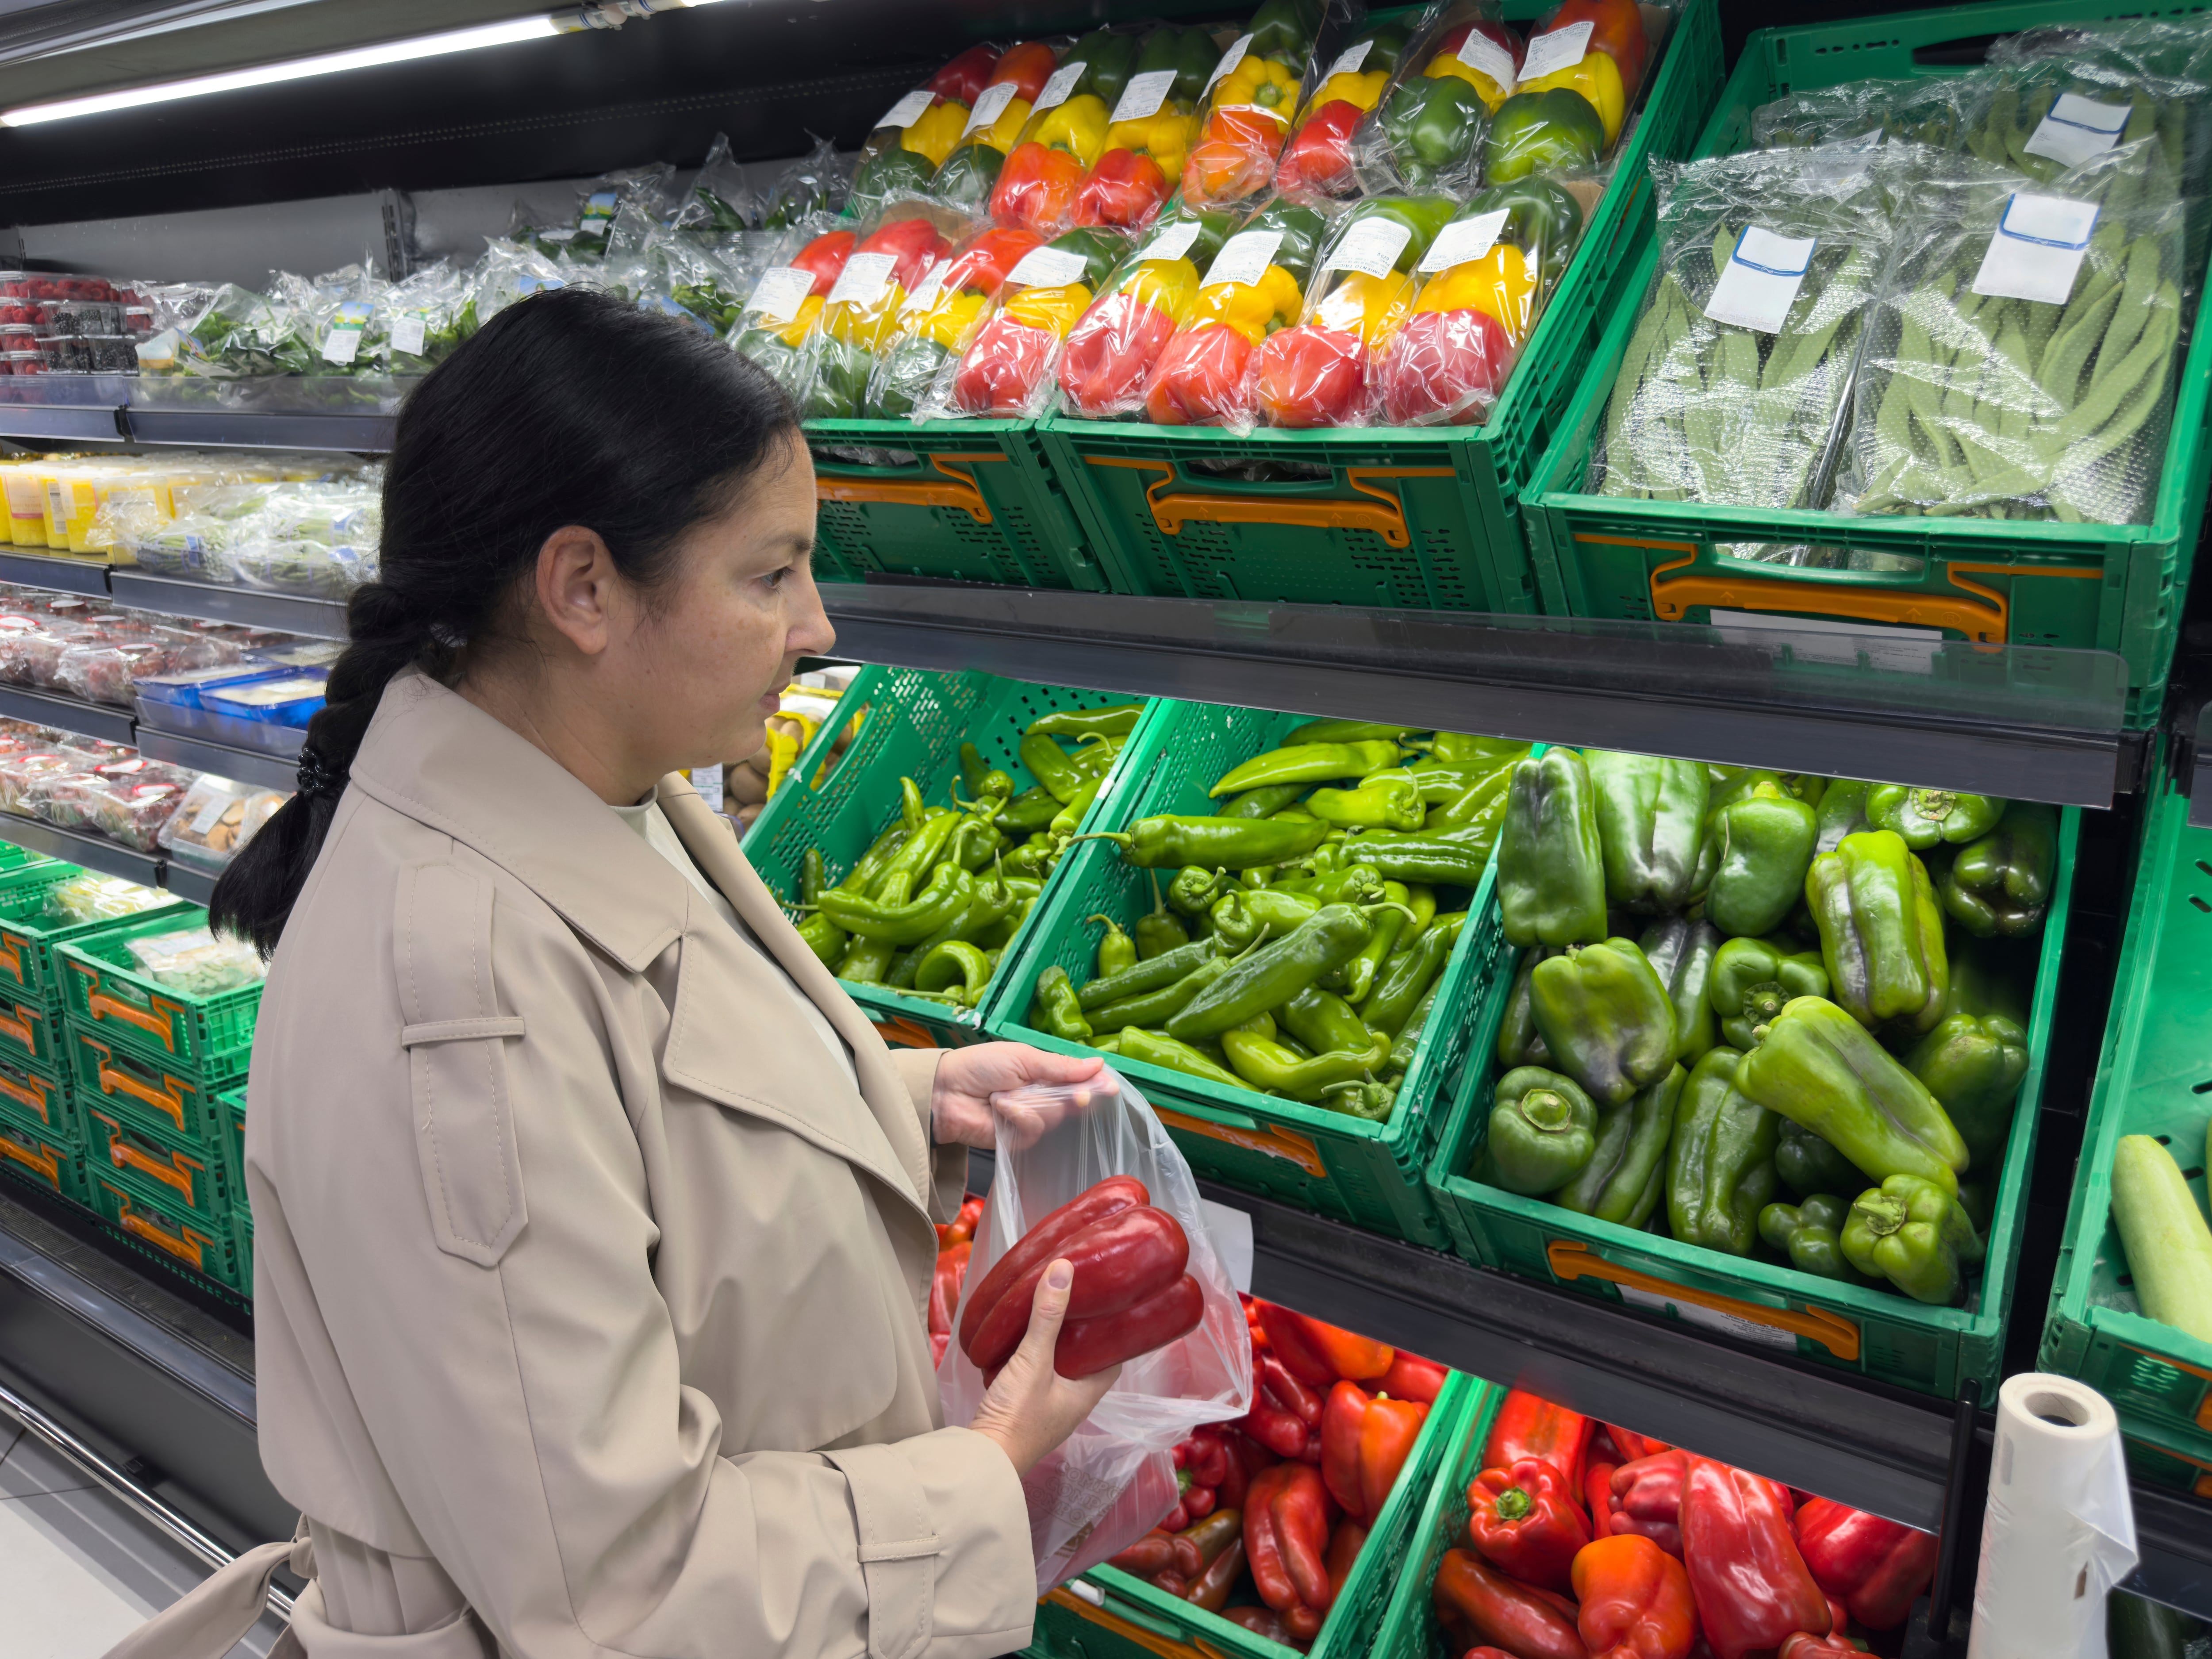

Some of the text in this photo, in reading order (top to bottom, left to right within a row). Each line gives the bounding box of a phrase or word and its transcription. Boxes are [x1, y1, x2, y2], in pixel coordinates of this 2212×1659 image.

[1533, 31, 1559, 43] PIMIENTO
[1355, 265, 1384, 276] PIMIENTO
[1228, 276, 1255, 284] PIMIENTO
